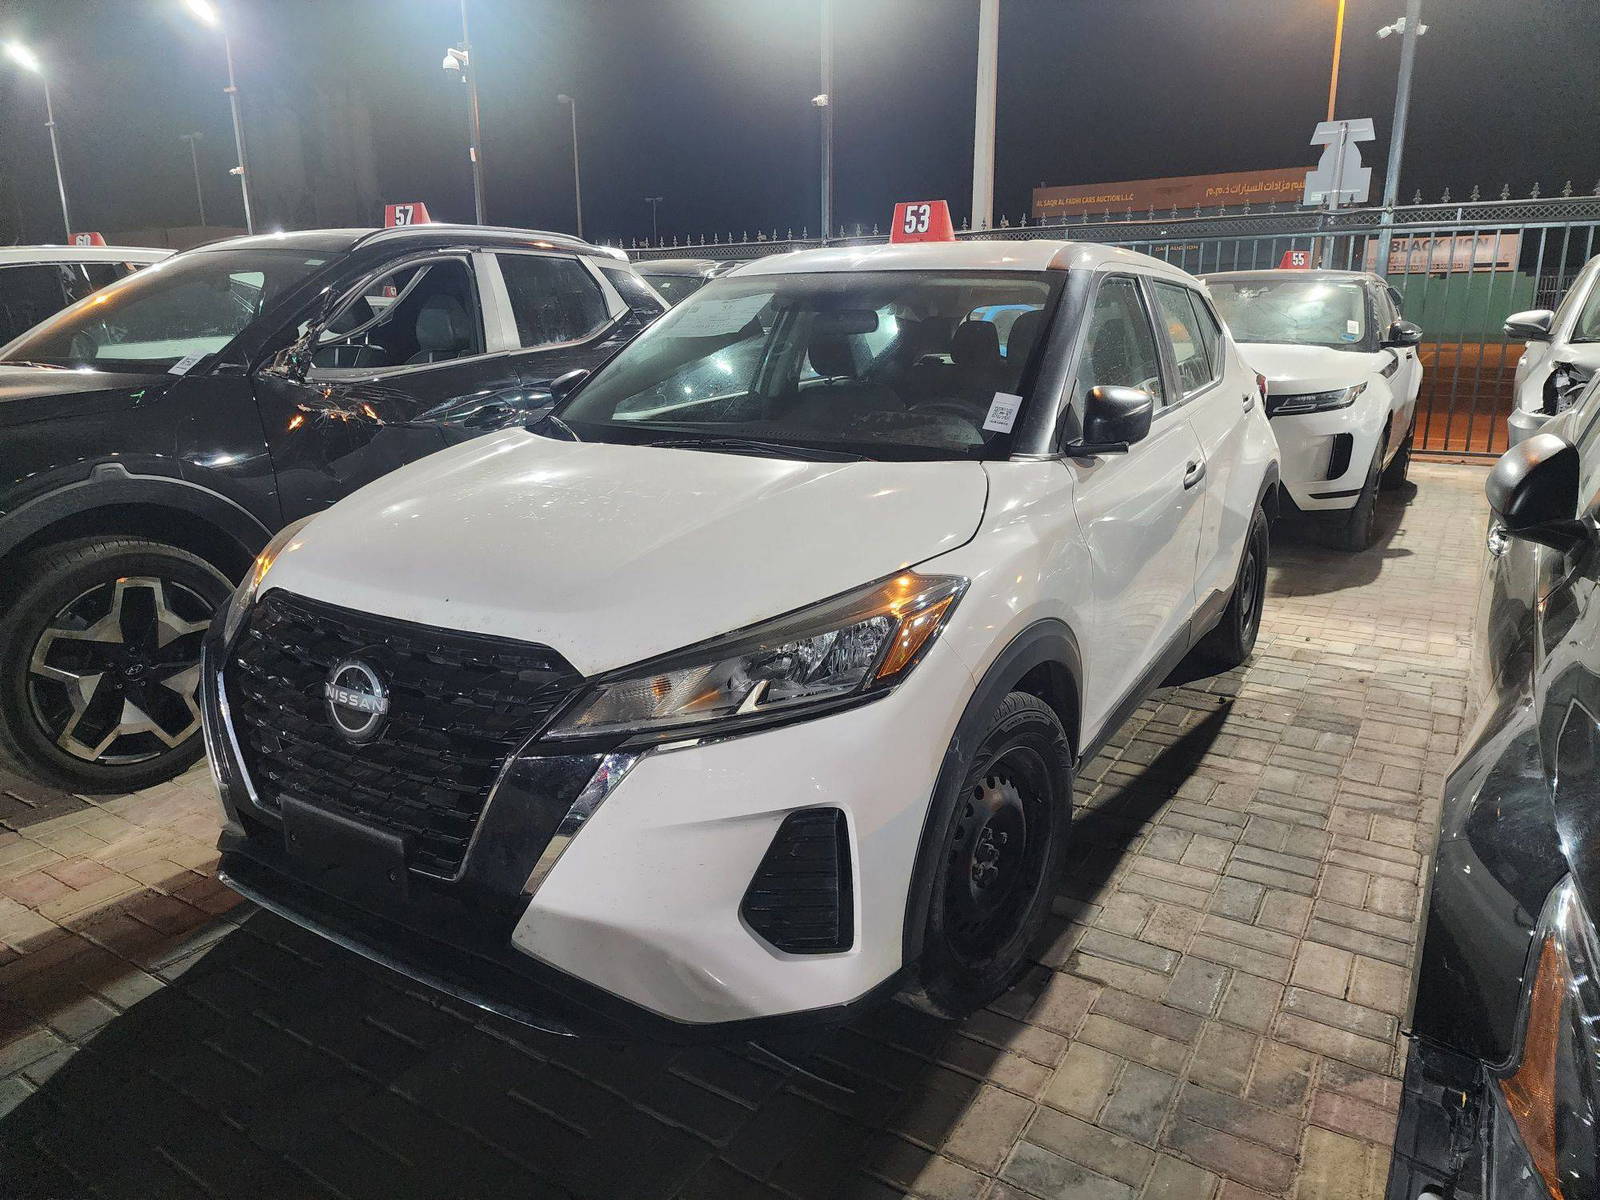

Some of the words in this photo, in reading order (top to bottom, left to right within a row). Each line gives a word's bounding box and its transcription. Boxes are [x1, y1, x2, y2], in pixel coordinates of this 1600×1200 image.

[1229, 181, 1263, 195] السيارات
[1264, 180, 1290, 193] مزادات
[1082, 196, 1095, 204] CARS
[1096, 194, 1120, 203] AUCTION
[395, 205, 413, 226] 57
[904, 204, 931, 234] 53
[1170, 244, 1198, 252] AUCION
[1390, 239, 1446, 253] BLACK
[1450, 237, 1488, 249] ION
[1292, 253, 1305, 266] 55
[325, 682, 385, 712] NISSAN
